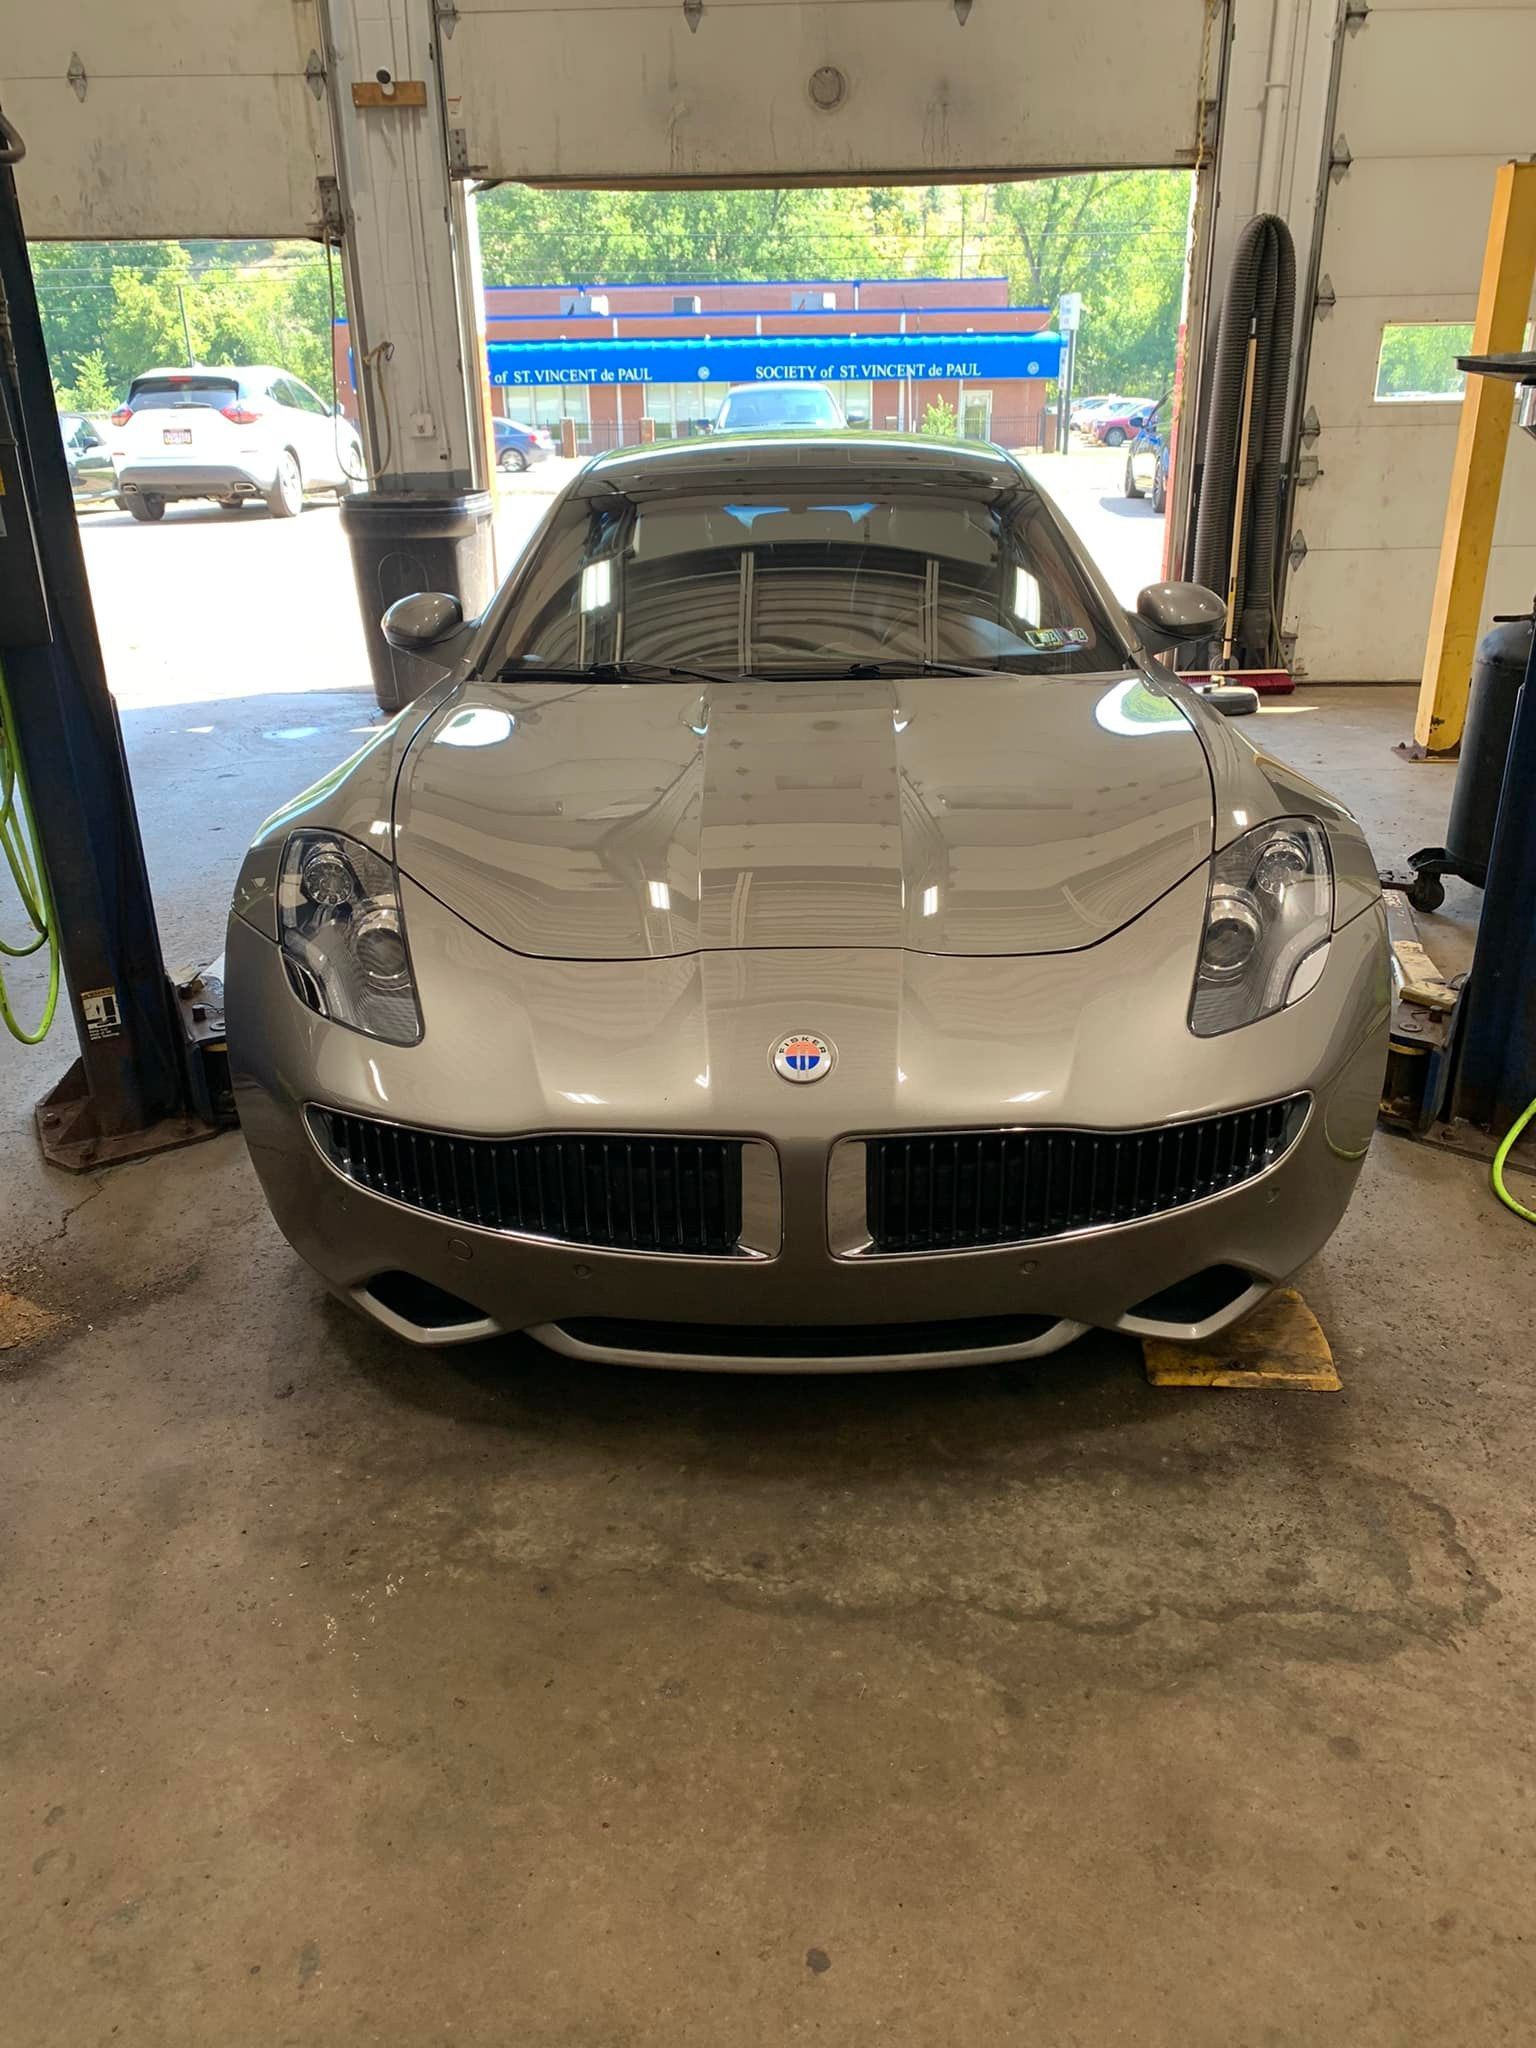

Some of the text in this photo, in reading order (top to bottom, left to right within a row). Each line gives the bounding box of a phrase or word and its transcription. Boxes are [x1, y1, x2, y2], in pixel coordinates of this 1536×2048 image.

[494, 370, 508, 384] of
[534, 368, 597, 383] VINCENT
[600, 368, 614, 382] de
[618, 367, 652, 382] PAUL
[755, 365, 817, 380] SOCIETY
[820, 364, 834, 379] of
[861, 362, 926, 378] VINCENT
[928, 362, 943, 377] de
[946, 362, 981, 377] PAUL
[779, 1036, 826, 1053] FISKER
